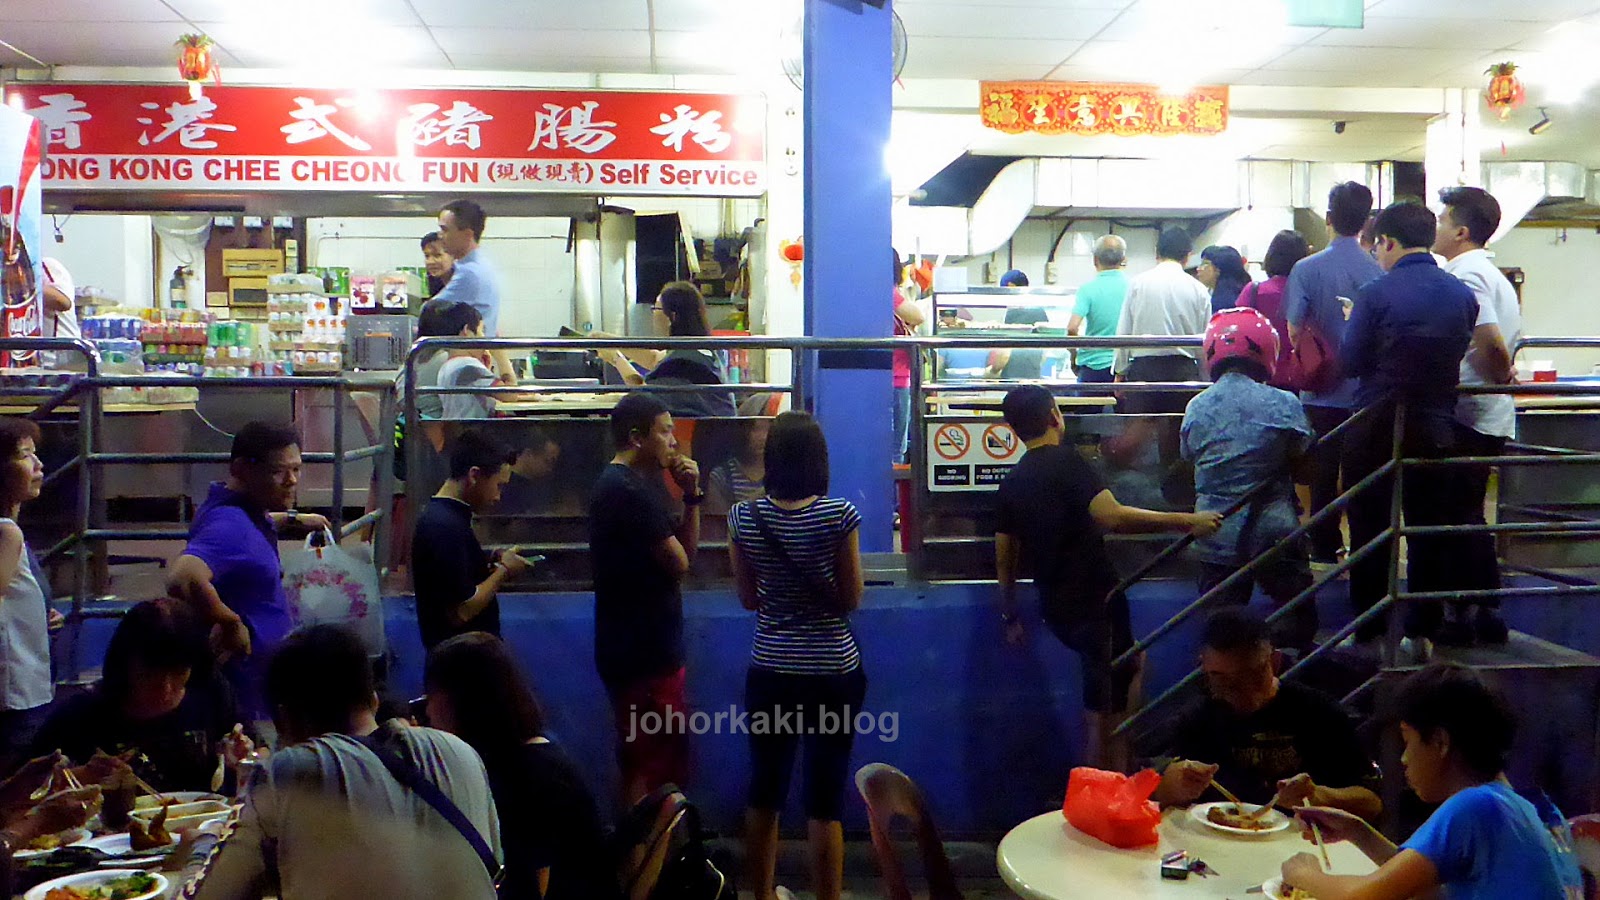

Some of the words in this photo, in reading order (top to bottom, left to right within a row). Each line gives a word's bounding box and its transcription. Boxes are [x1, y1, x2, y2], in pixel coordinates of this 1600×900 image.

[41, 158, 99, 181] ONG
[109, 158, 193, 181] KONG
[203, 159, 281, 182] CHEE
[422, 161, 479, 184] FUN
[600, 162, 650, 185] Self
[659, 163, 758, 187] Service
